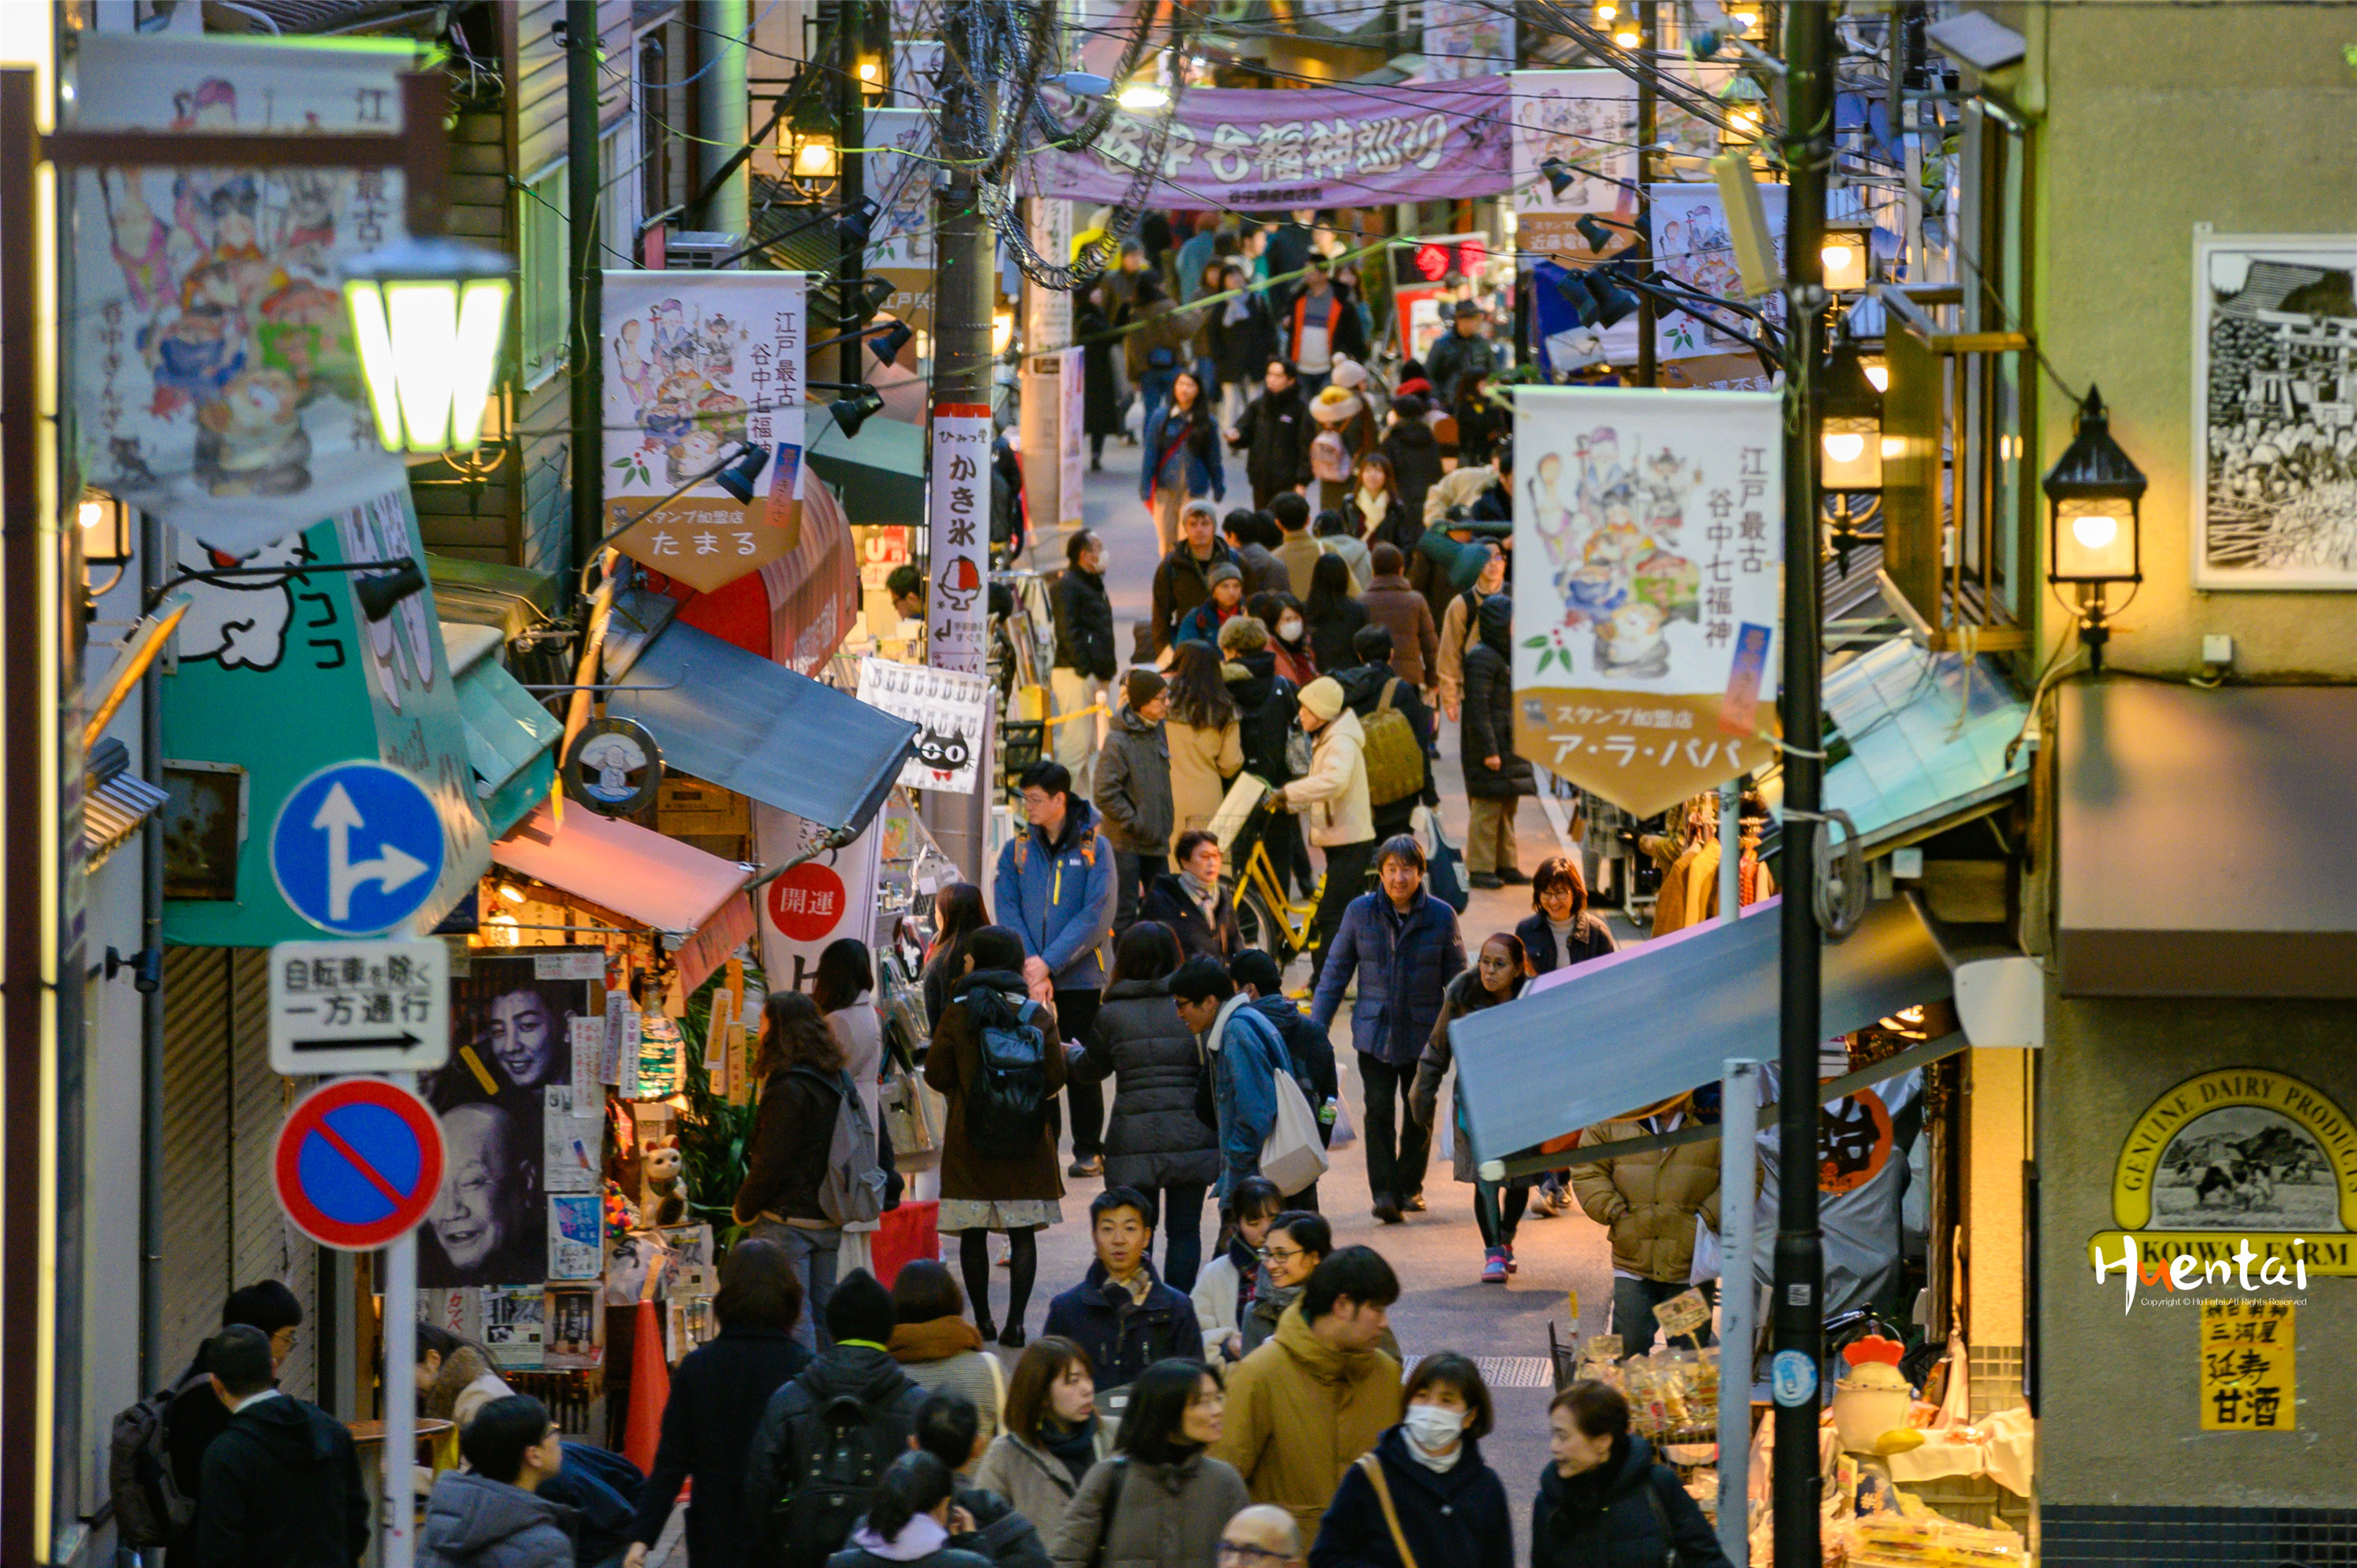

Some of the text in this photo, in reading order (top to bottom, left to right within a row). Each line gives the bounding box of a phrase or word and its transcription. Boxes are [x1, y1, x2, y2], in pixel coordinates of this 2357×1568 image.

[775, 312, 797, 407] 江戸最古
[947, 454, 977, 547] かき氷
[1739, 447, 1769, 574] 江戸最古
[651, 530, 757, 555] たまる
[1705, 489, 1735, 649] 谷中七福神
[780, 887, 834, 916] 開運
[285, 954, 430, 990] 自転車を除く
[284, 990, 431, 1025] 一方通行
[2123, 1075, 2357, 1193] GENUINE DAIRY PRODUCTS
[2264, 1241, 2348, 1266] FARM
[2212, 1387, 2281, 1427] 甘酒
